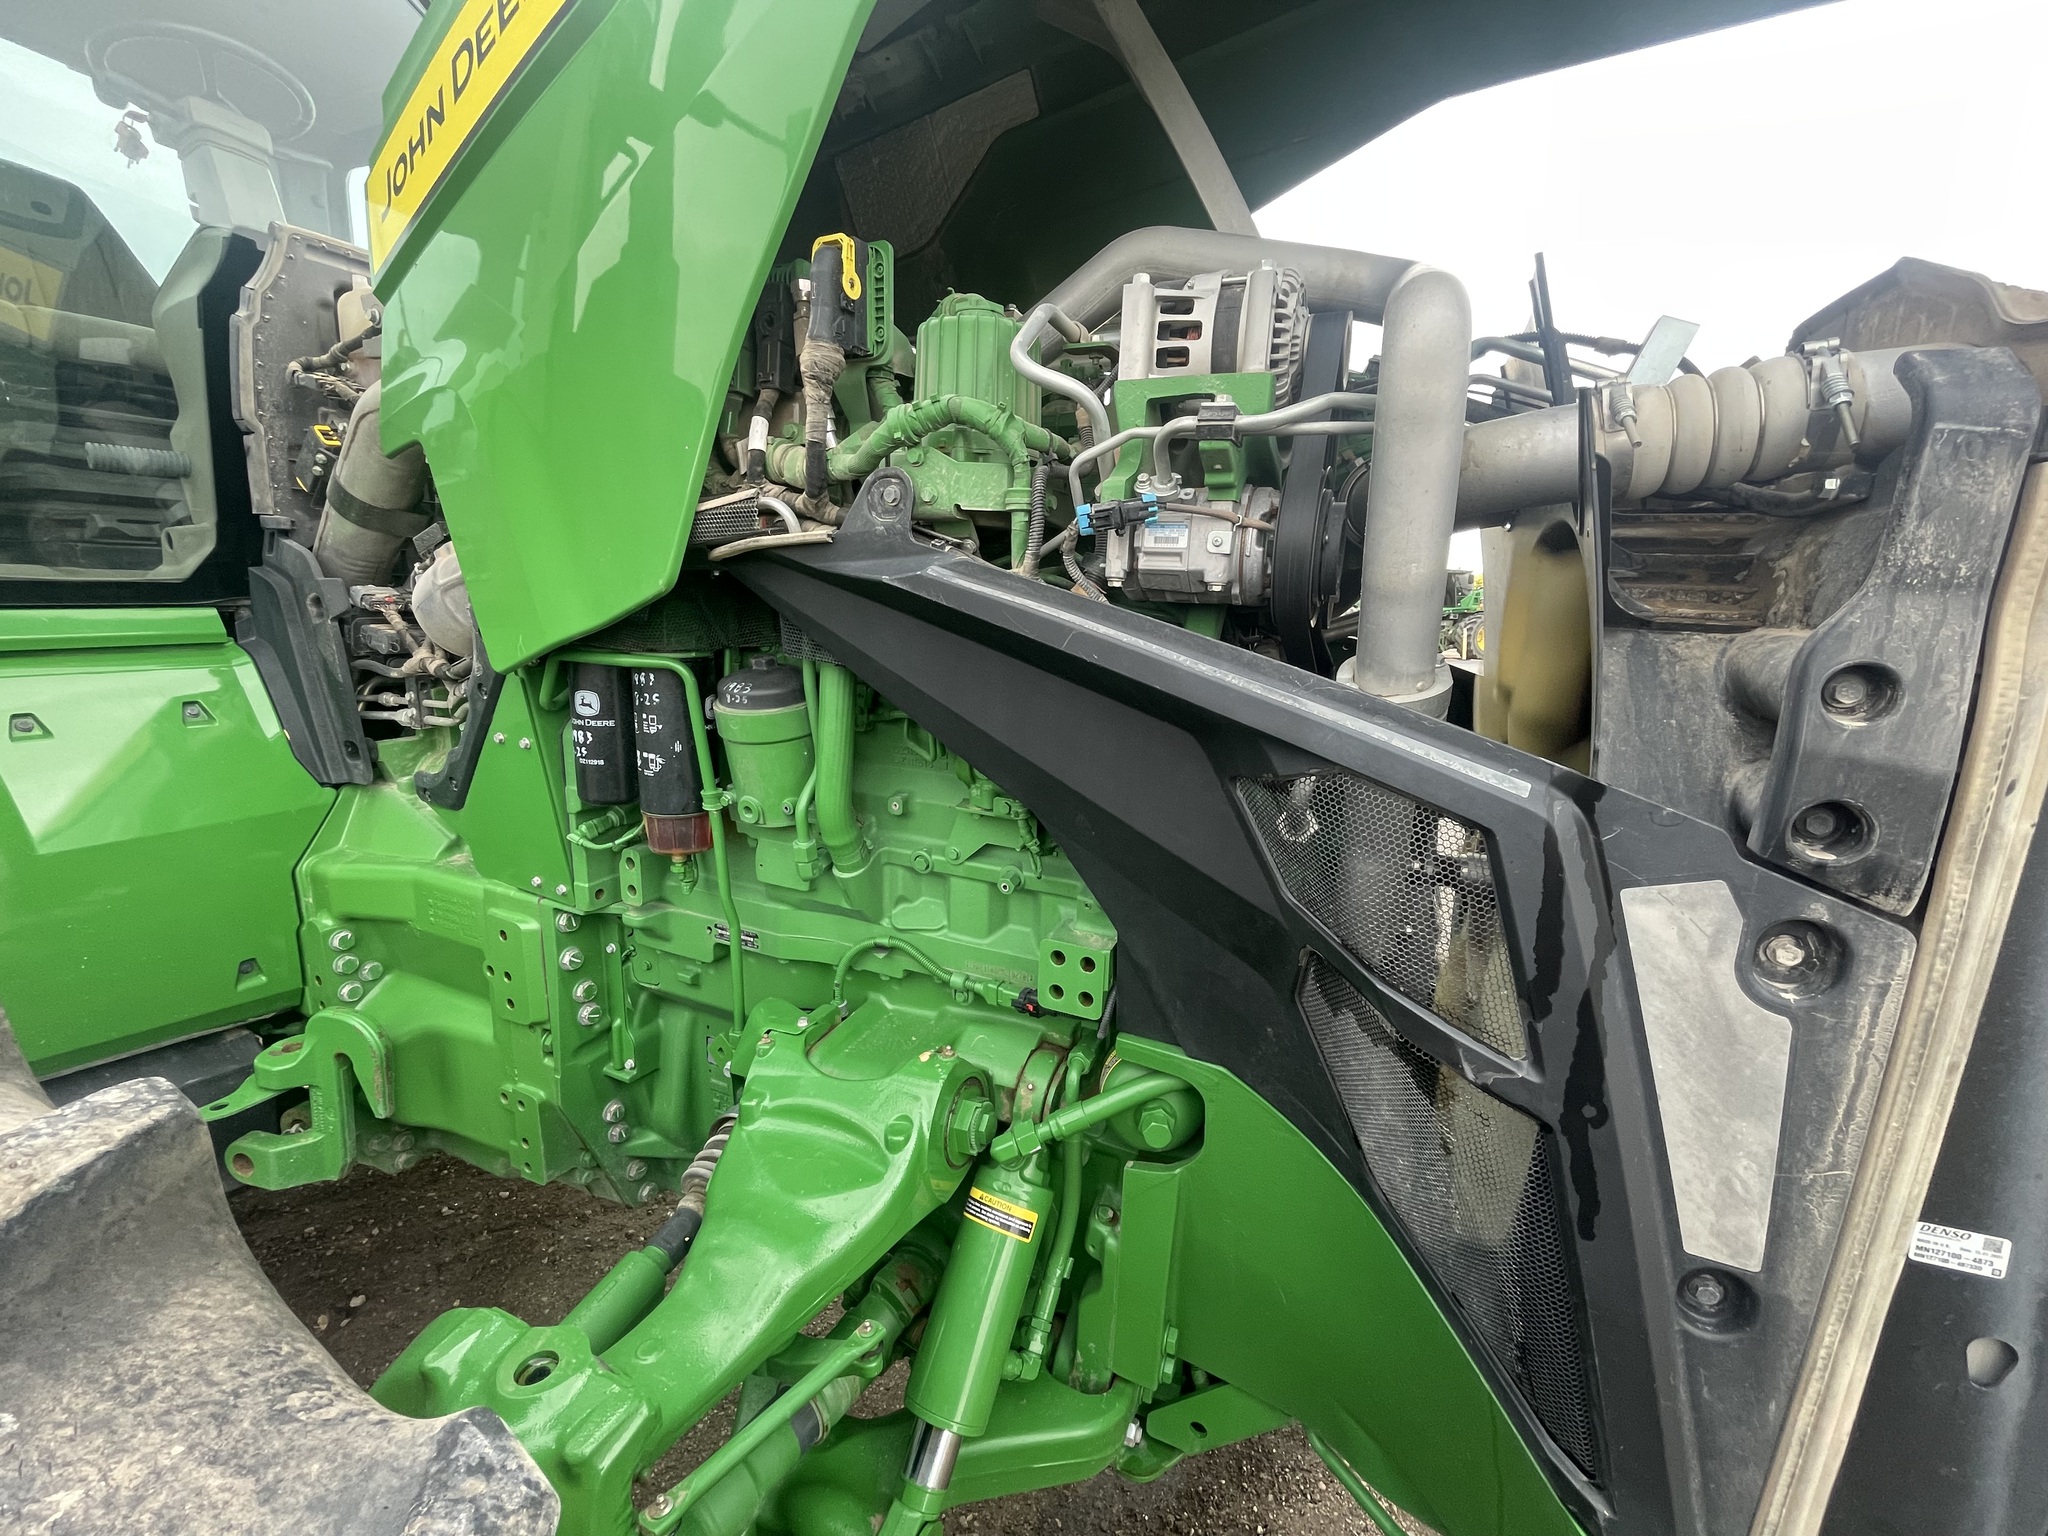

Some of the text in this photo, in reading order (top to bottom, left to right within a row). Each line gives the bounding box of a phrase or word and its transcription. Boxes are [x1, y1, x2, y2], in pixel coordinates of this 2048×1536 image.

[381, 0, 526, 223] JOHN DEE
[723, 682, 753, 694] 1983
[571, 718, 616, 727] OHN DEERE
[984, 1195, 1012, 1212] CAUTION
[1920, 1224, 1972, 1241] DENSO
